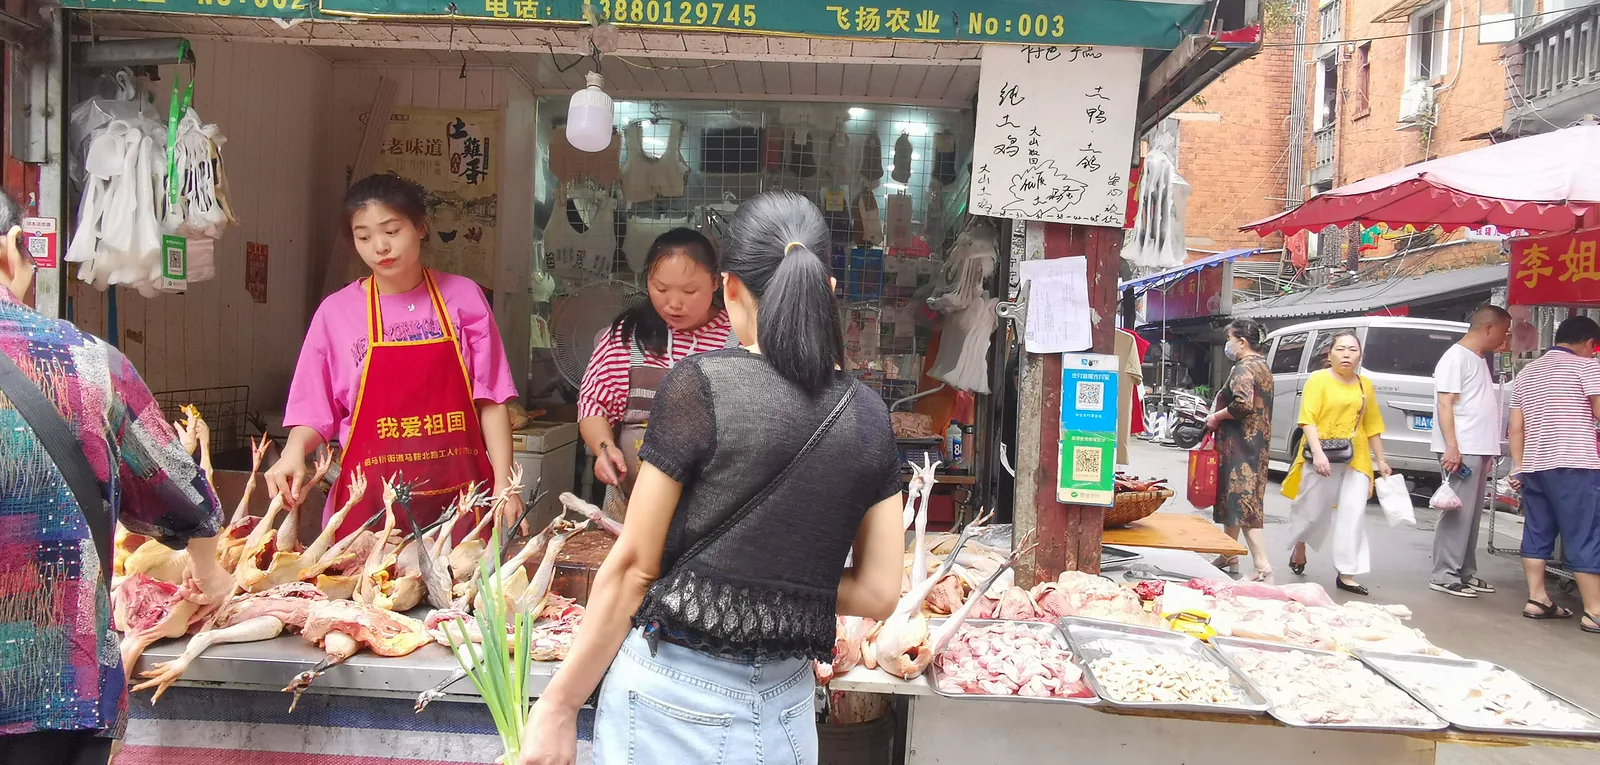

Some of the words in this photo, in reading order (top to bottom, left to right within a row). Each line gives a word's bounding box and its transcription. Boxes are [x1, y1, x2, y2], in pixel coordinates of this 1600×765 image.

[826, 6, 940, 34] 飞扬农业
[968, 12, 1065, 37] No:003
[1516, 238, 1600, 289] 李姐
[376, 411, 466, 439] 我爱祖国
